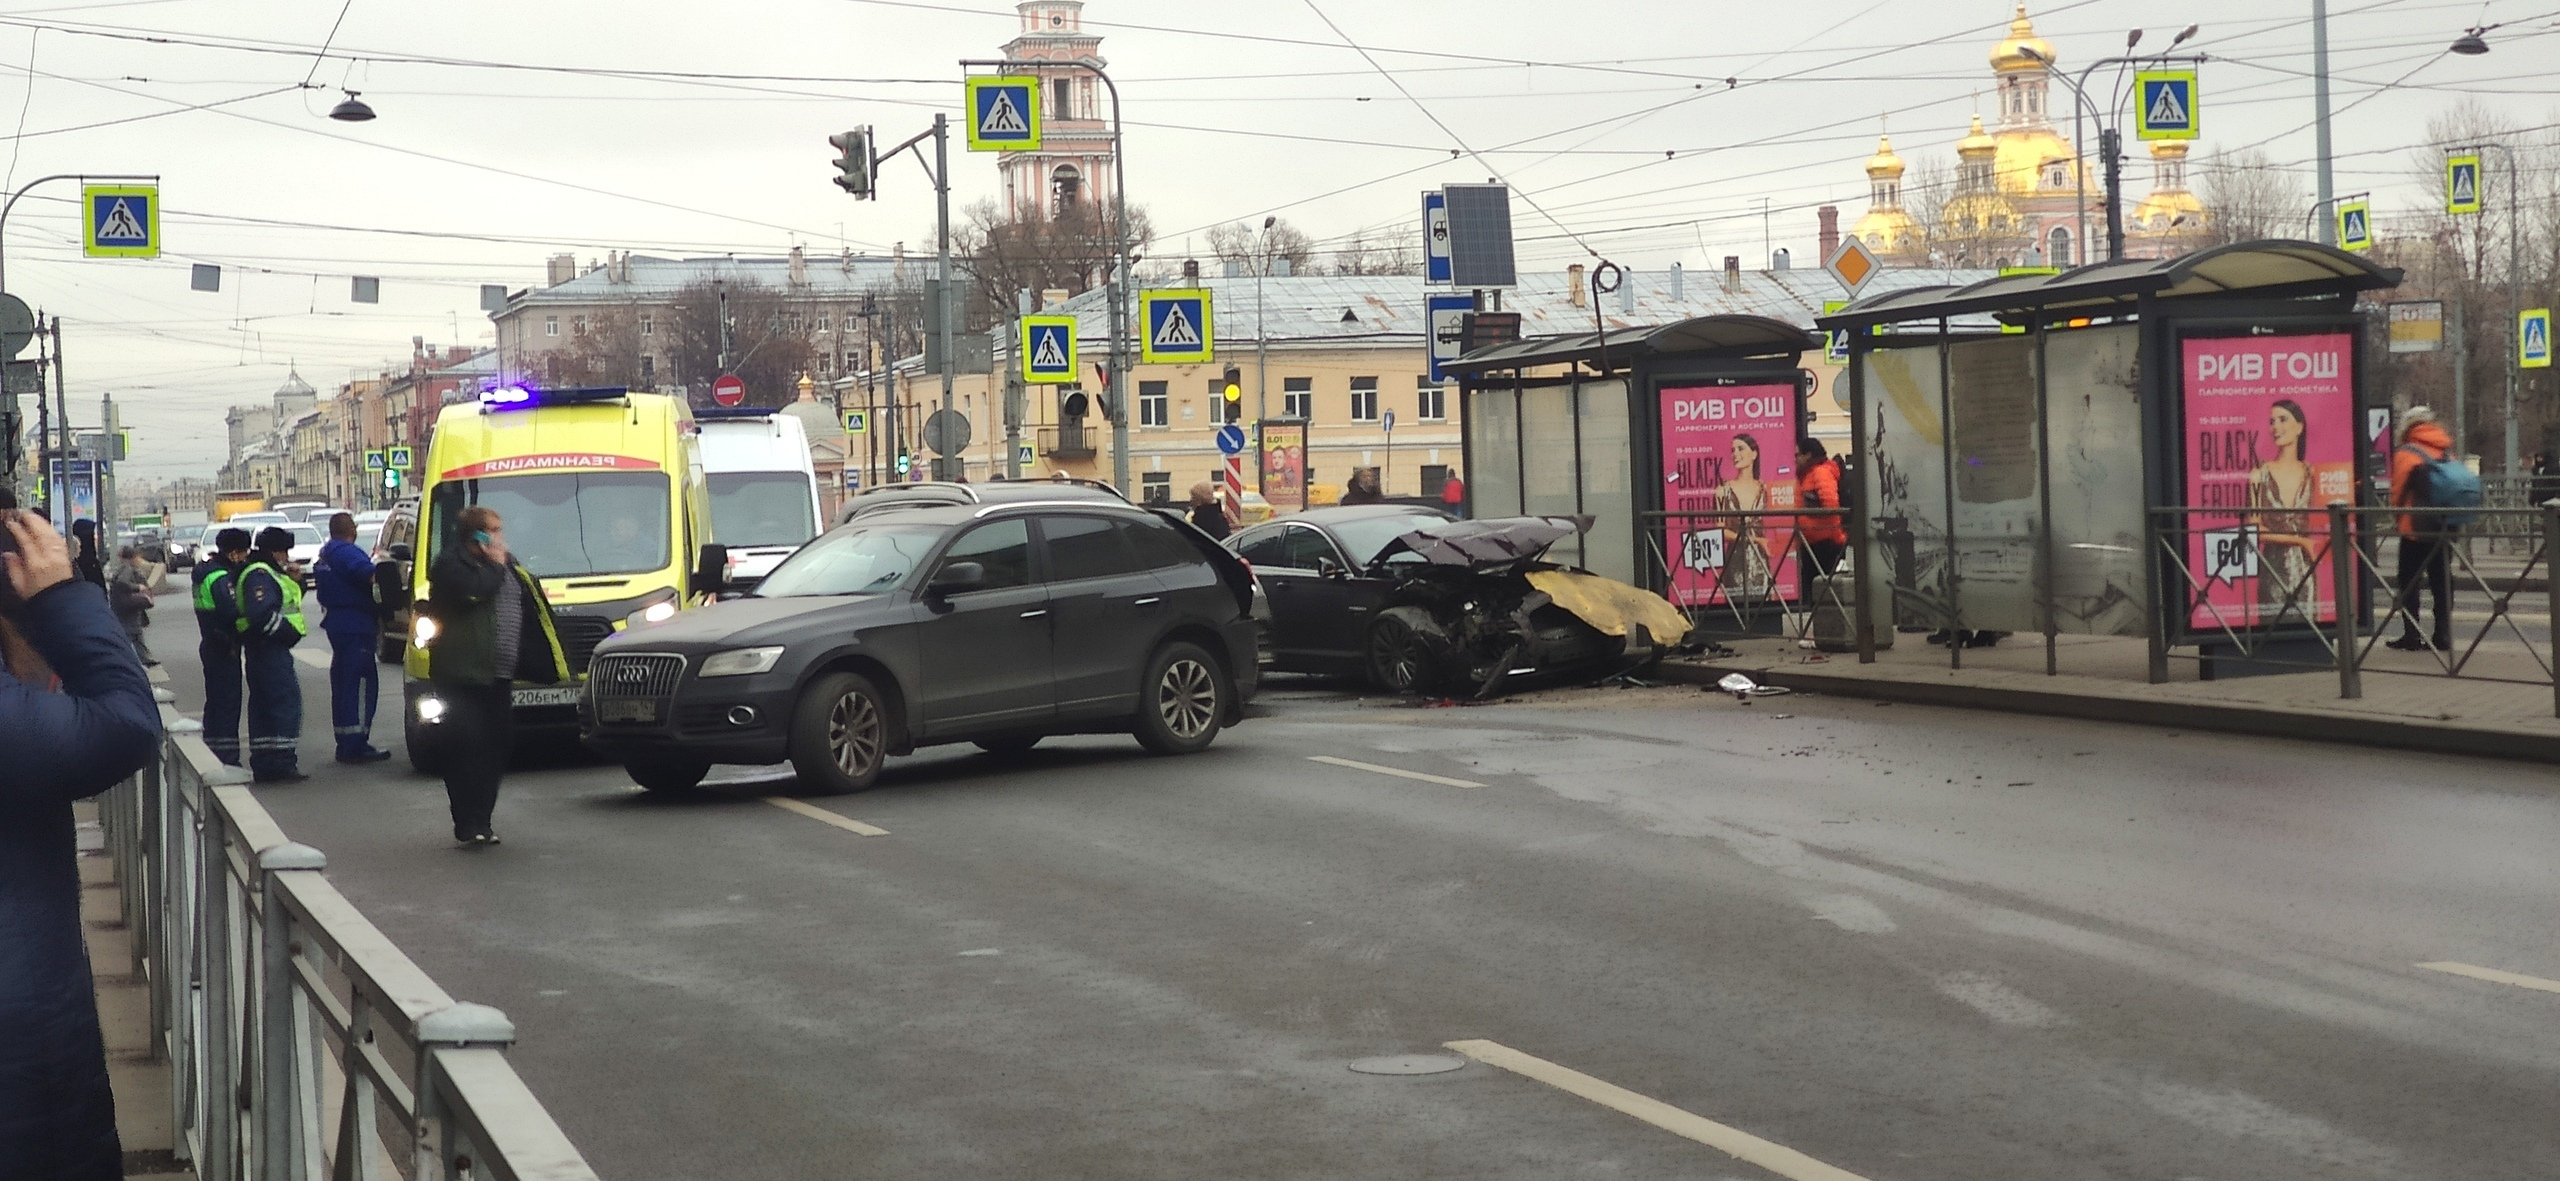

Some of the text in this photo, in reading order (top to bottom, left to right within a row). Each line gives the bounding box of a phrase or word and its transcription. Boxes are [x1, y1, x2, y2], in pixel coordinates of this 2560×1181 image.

[2198, 352, 2339, 381] РИВ ГОШ
[2199, 387, 2266, 397] ПАРФЮМЕРИЯ
[2280, 385, 2339, 395] КОСМЕТИКА
[1674, 396, 1784, 421] РИВ ГОШ
[1675, 423, 1728, 432] ПАРФЮМЕРИЯ
[1738, 422, 1784, 431] КОСМЕТИКА
[2200, 430, 2259, 471] BLACK
[1677, 457, 1724, 489] BLACK
[2319, 470, 2349, 483] РИВ
[1771, 486, 1794, 496] РИВ
